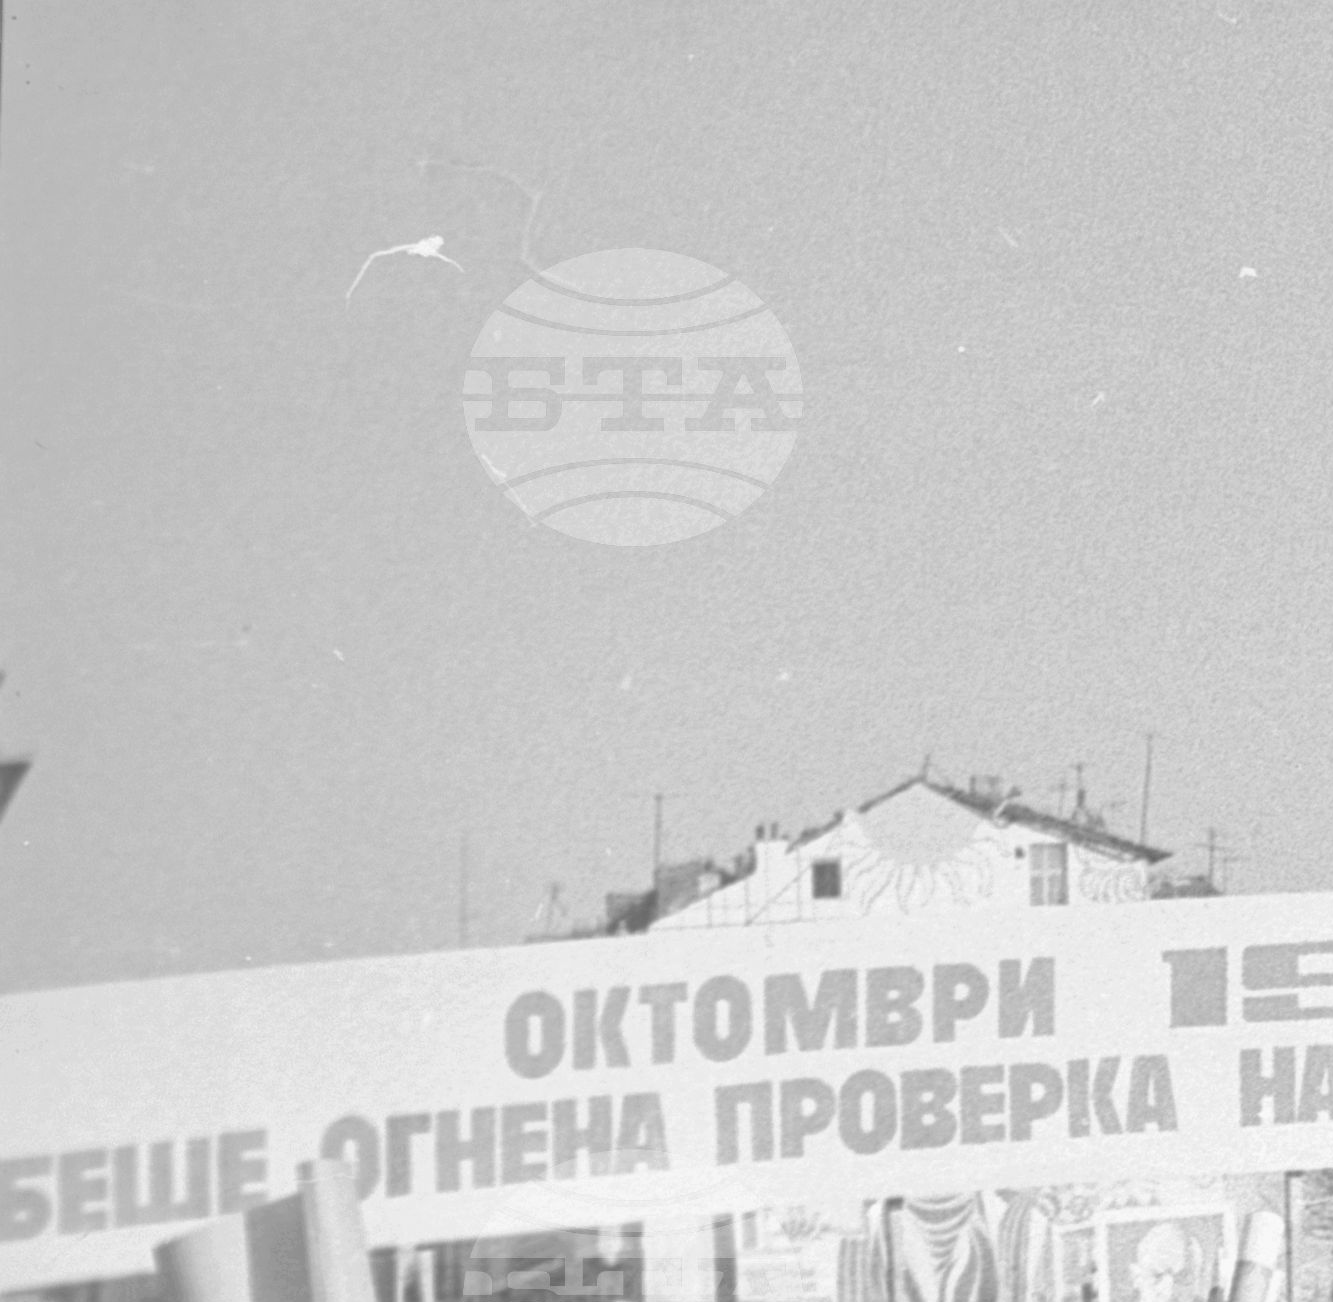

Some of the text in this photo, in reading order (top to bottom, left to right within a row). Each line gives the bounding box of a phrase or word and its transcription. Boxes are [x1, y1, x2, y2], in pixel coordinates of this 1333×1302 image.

[503, 956, 1056, 1080] ОКТОМВРИ
[0, 1128, 268, 1242] БЕШЕ
[318, 1091, 672, 1202] ОГНЕНА
[714, 1053, 1179, 1166] ПРОВЕРКА
